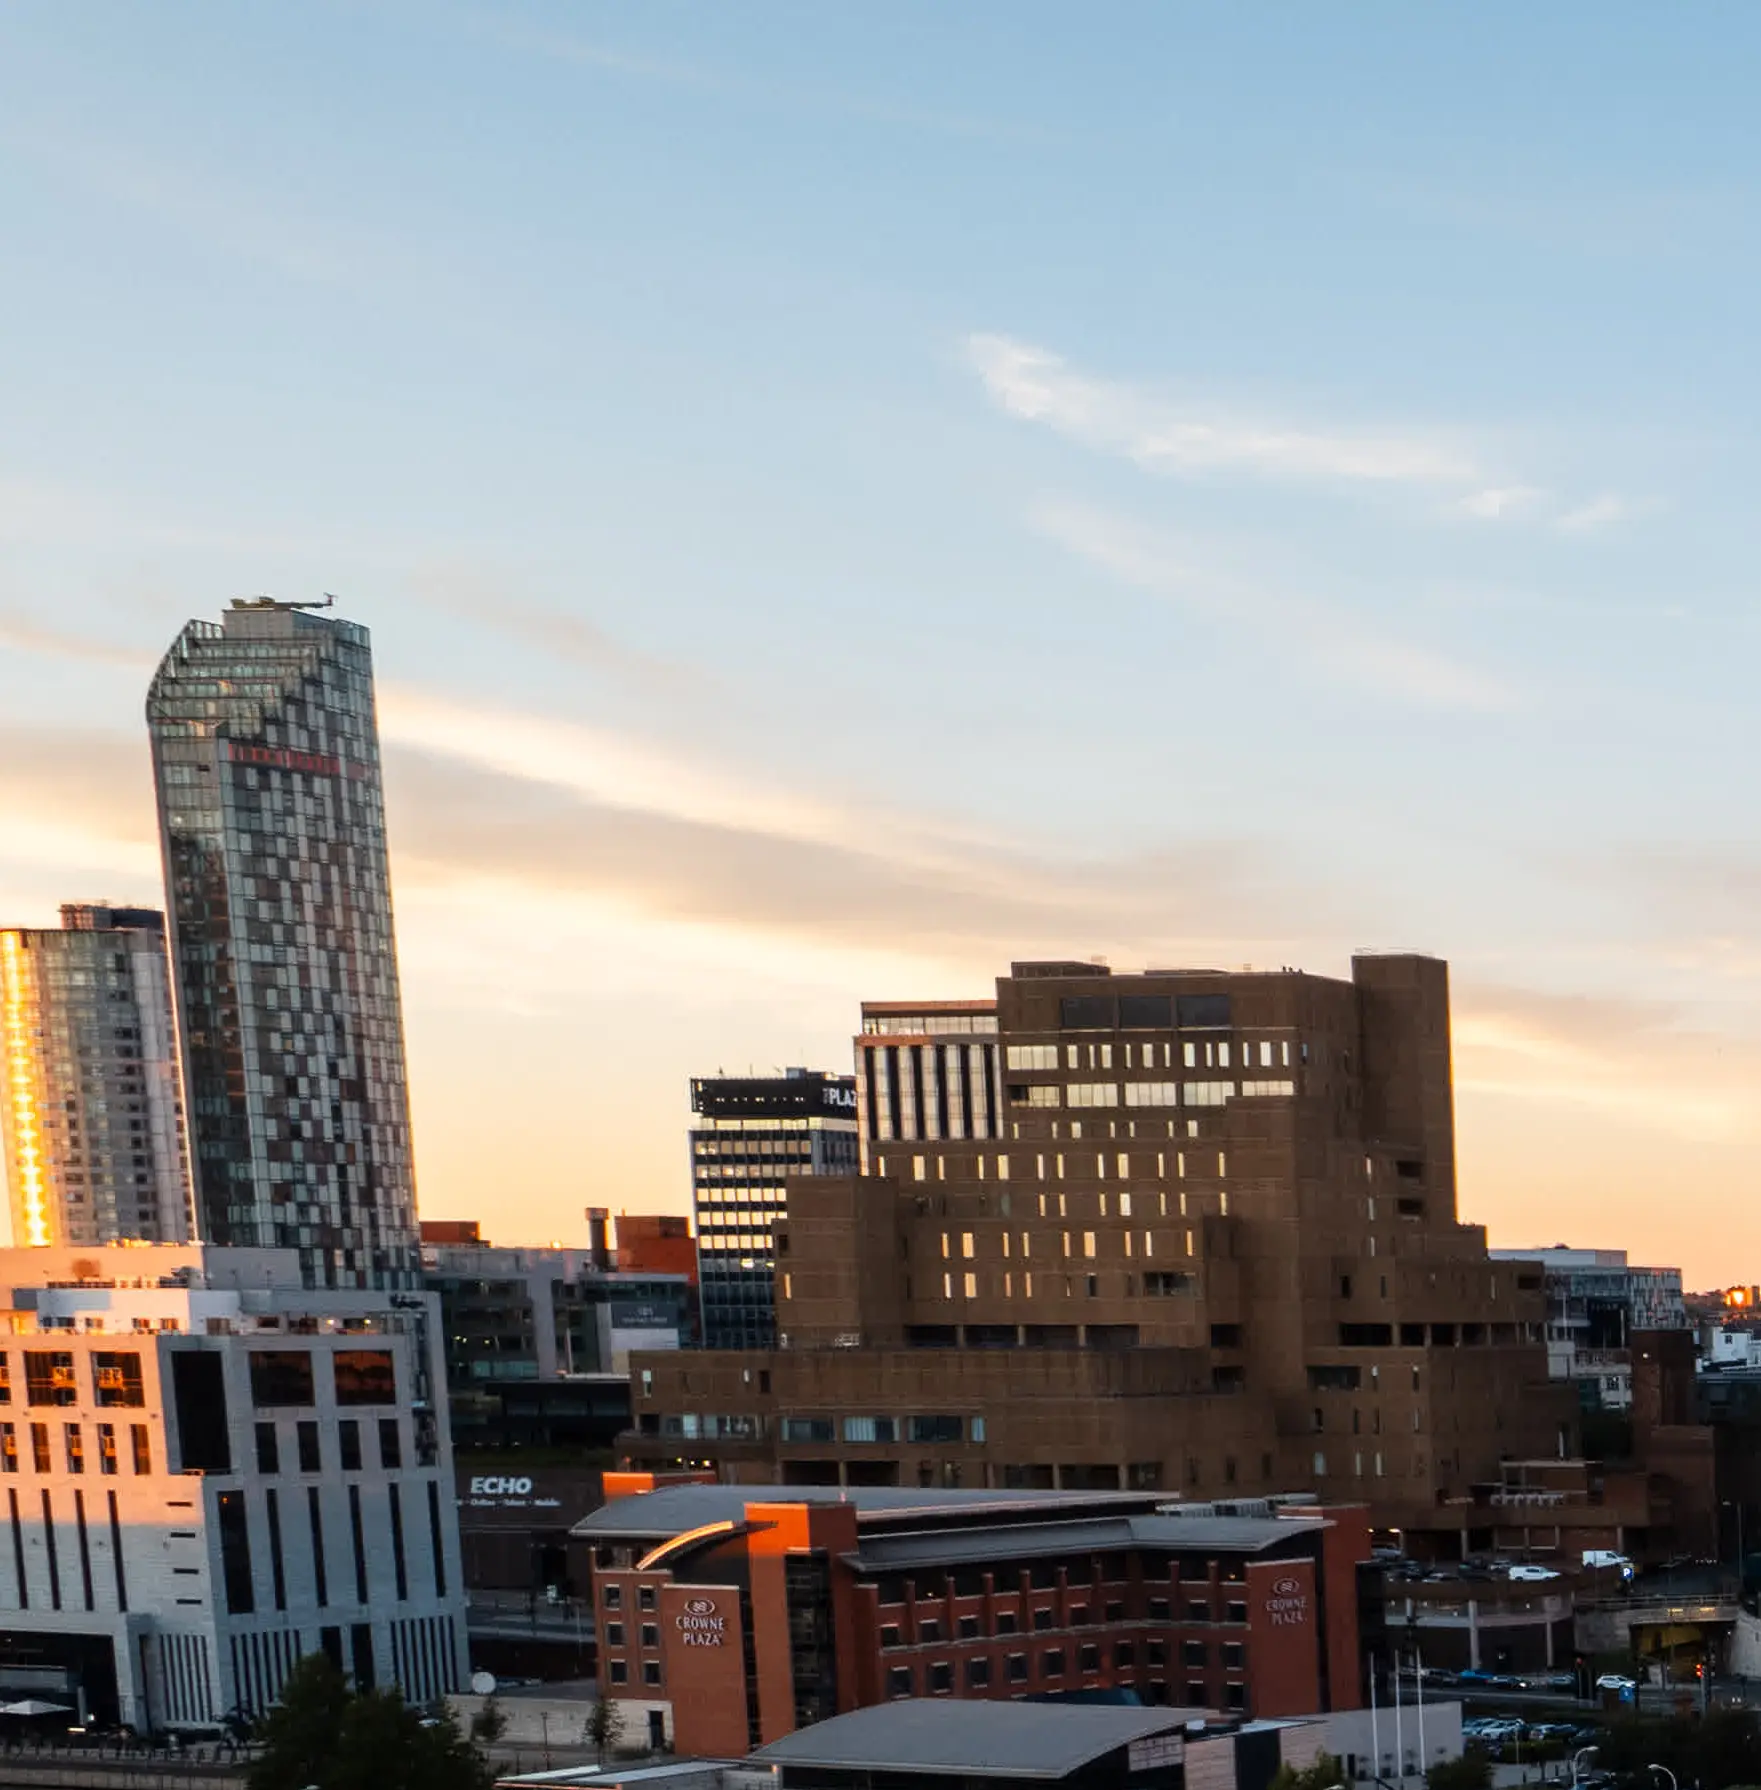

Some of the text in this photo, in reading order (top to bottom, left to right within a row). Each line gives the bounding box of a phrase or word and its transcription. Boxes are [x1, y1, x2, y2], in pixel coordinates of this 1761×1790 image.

[829, 1087, 858, 1106] PLAZ
[470, 1476, 532, 1494] ECHO
[676, 1616, 724, 1631] CROWNE
[683, 1632, 720, 1646] PLAZA
